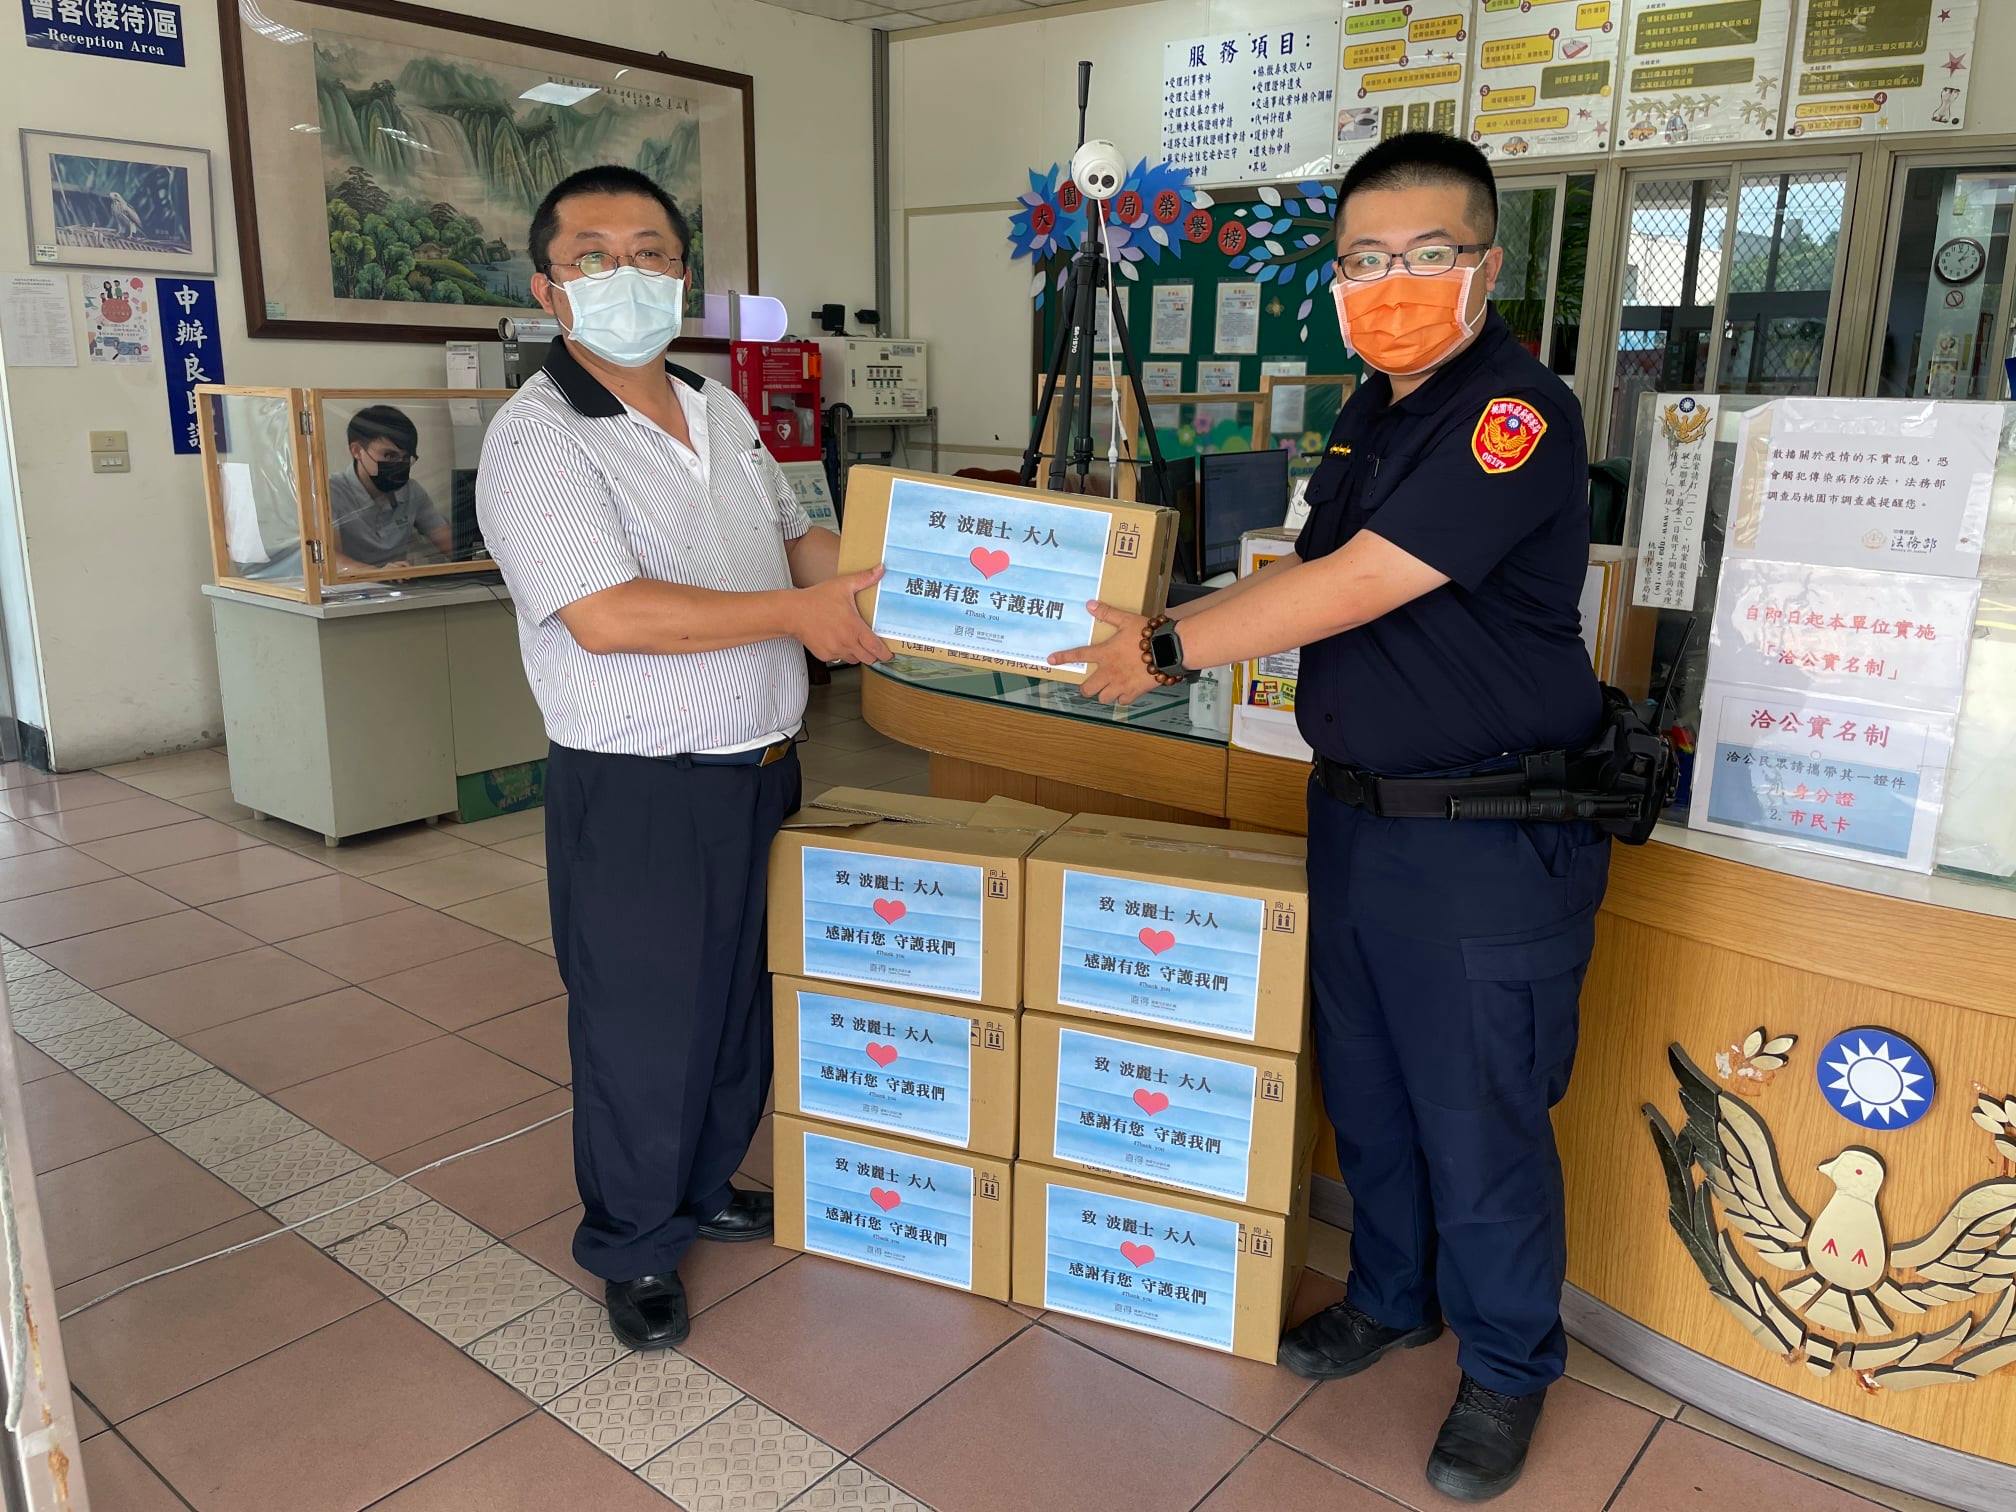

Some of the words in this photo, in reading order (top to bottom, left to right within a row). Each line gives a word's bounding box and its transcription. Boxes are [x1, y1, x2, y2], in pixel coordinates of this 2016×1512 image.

[48, 27, 124, 49] Reception
[130, 42, 165, 56] Area
[1169, 72, 1212, 89] 受理刑事案件
[1256, 77, 1302, 93] 受理證件遺失
[1168, 88, 1211, 104] 受理交通案件
[1168, 102, 1225, 119] 受理家庭暴力案件
[1255, 90, 1333, 110] 交通事故案件轉介調解
[1255, 111, 1293, 125] 代叫計程車
[1167, 131, 1246, 149] 道路交通事故證明書申請
[1253, 143, 1291, 158] 遺失物申請
[1252, 161, 1268, 173] 其他
[1037, 187, 1243, 249] 大園局榮譽榜
[929, 510, 947, 529] 致
[957, 514, 1012, 540] 波麗士
[1022, 525, 1060, 548] 大人
[1119, 521, 1139, 534] 向上
[905, 577, 980, 605] 感謝有您
[990, 591, 1065, 621] 守護我們
[1746, 605, 1937, 641] 自即日起本單位實施
[1749, 709, 1891, 748] 洽公實名制
[1726, 751, 1906, 790] 洽公民眾請攜帶其一證件
[1792, 782, 1856, 808] 身分證
[1769, 808, 1782, 822] 2.
[1790, 809, 1851, 835] 市民卡
[836, 870, 850, 886] 致
[859, 873, 904, 892] 波麗士
[913, 879, 944, 897] 大人
[1099, 896, 1115, 912] 致
[1125, 900, 1175, 922] 波麗士
[1185, 909, 1219, 929] 大人
[1275, 901, 1294, 911] 向上
[825, 926, 886, 946] 感謝有您
[895, 934, 956, 956] 守護我們
[1084, 953, 1151, 978] 感謝有您
[1160, 965, 1229, 992] 守護我們
[831, 1013, 845, 1028] 致
[852, 1016, 896, 1037] 波麗士
[905, 1026, 934, 1044] 大人
[820, 1066, 879, 1088] 感謝有您
[887, 1077, 945, 1101] 守護我們
[1095, 1056, 1110, 1072] 致
[1120, 1061, 1169, 1085] 波麗士
[1179, 1073, 1212, 1093] 大人
[1263, 1070, 1281, 1080] 向上
[1079, 1111, 1145, 1137] 感謝有您
[1154, 1127, 1221, 1155] 守護我們
[835, 1158, 849, 1172] 致
[857, 1162, 900, 1184] 波麗士
[907, 1174, 937, 1192] 大人
[825, 1207, 882, 1231] 感謝有您
[890, 1221, 947, 1247] 守護我們
[1082, 1209, 1097, 1226] 致
[1106, 1214, 1154, 1238] 波麗士
[1164, 1227, 1196, 1246] 大人
[1068, 1262, 1133, 1288] 感謝有您
[1142, 1278, 1208, 1305] 守護我們
